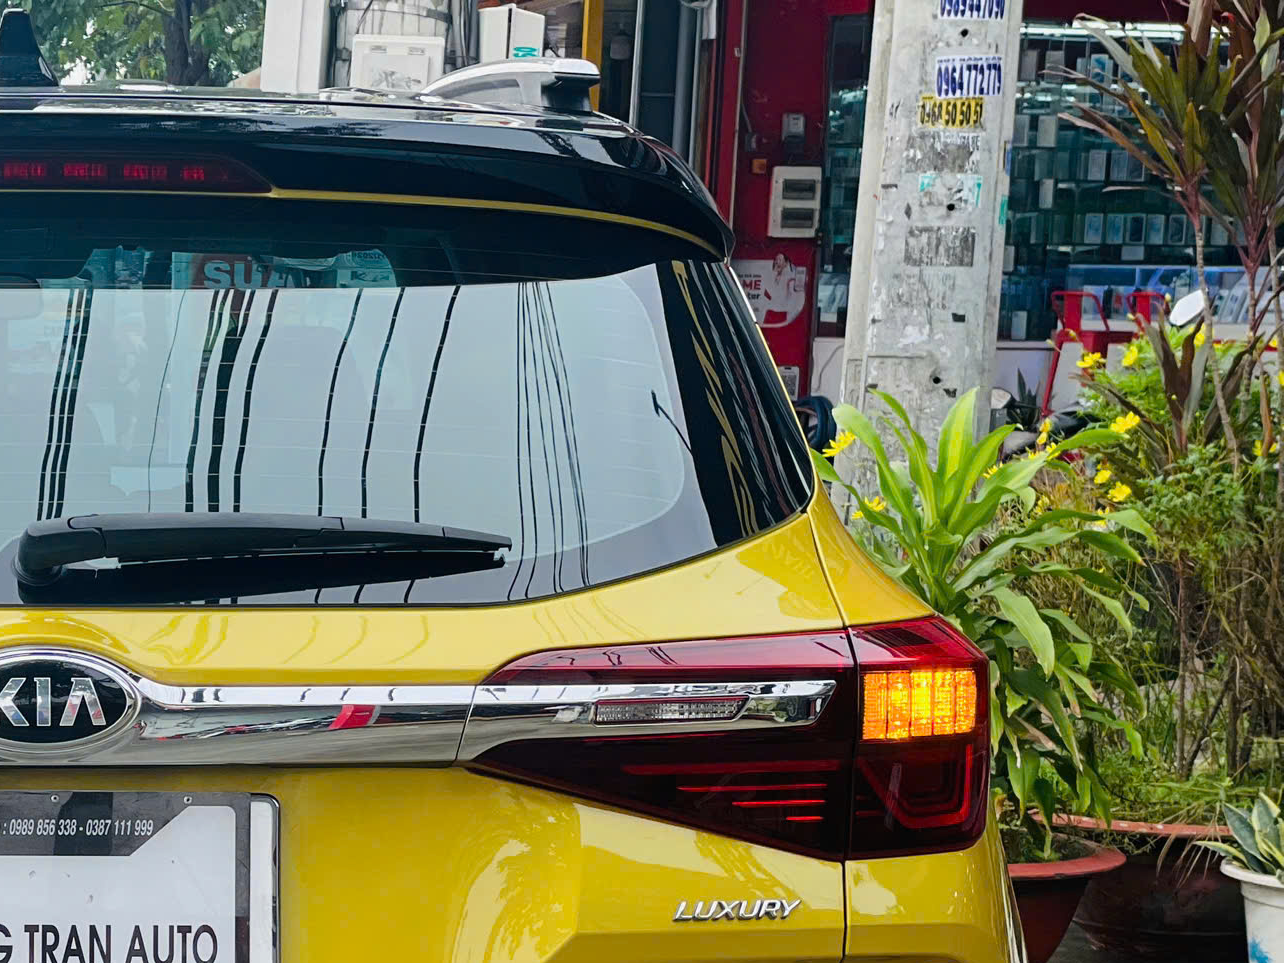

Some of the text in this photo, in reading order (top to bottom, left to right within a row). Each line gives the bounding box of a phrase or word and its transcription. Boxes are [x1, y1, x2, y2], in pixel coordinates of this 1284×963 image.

[936, 63, 1002, 97] 0964772779
[9, 818, 35, 836] 0989
[36, 818, 56, 836] 856
[57, 818, 77, 836] 338
[85, 818, 112, 837] 0387
[114, 819, 132, 837] 111
[134, 819, 154, 837] 999
[673, 899, 803, 922] LUXURY
